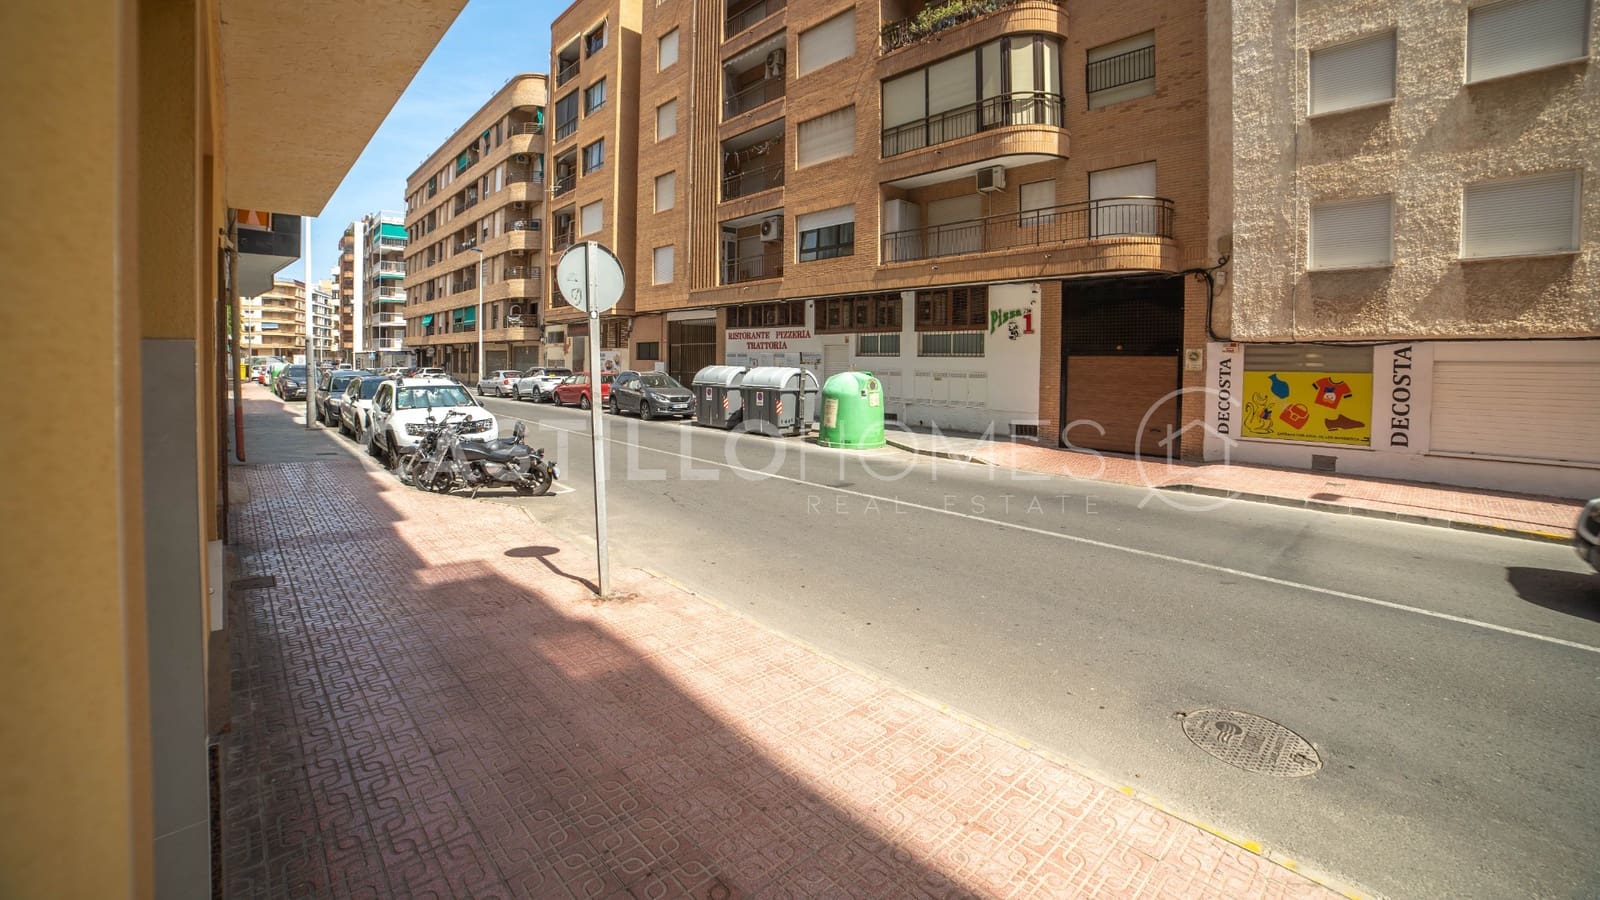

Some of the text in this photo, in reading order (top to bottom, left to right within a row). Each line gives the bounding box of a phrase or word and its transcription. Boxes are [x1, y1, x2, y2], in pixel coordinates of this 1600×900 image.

[728, 331, 770, 340] RISTORANTE
[747, 341, 787, 350] TRATTORIA
[1217, 358, 1232, 435] DECOSTA
[1390, 345, 1412, 448] DECOSTA
